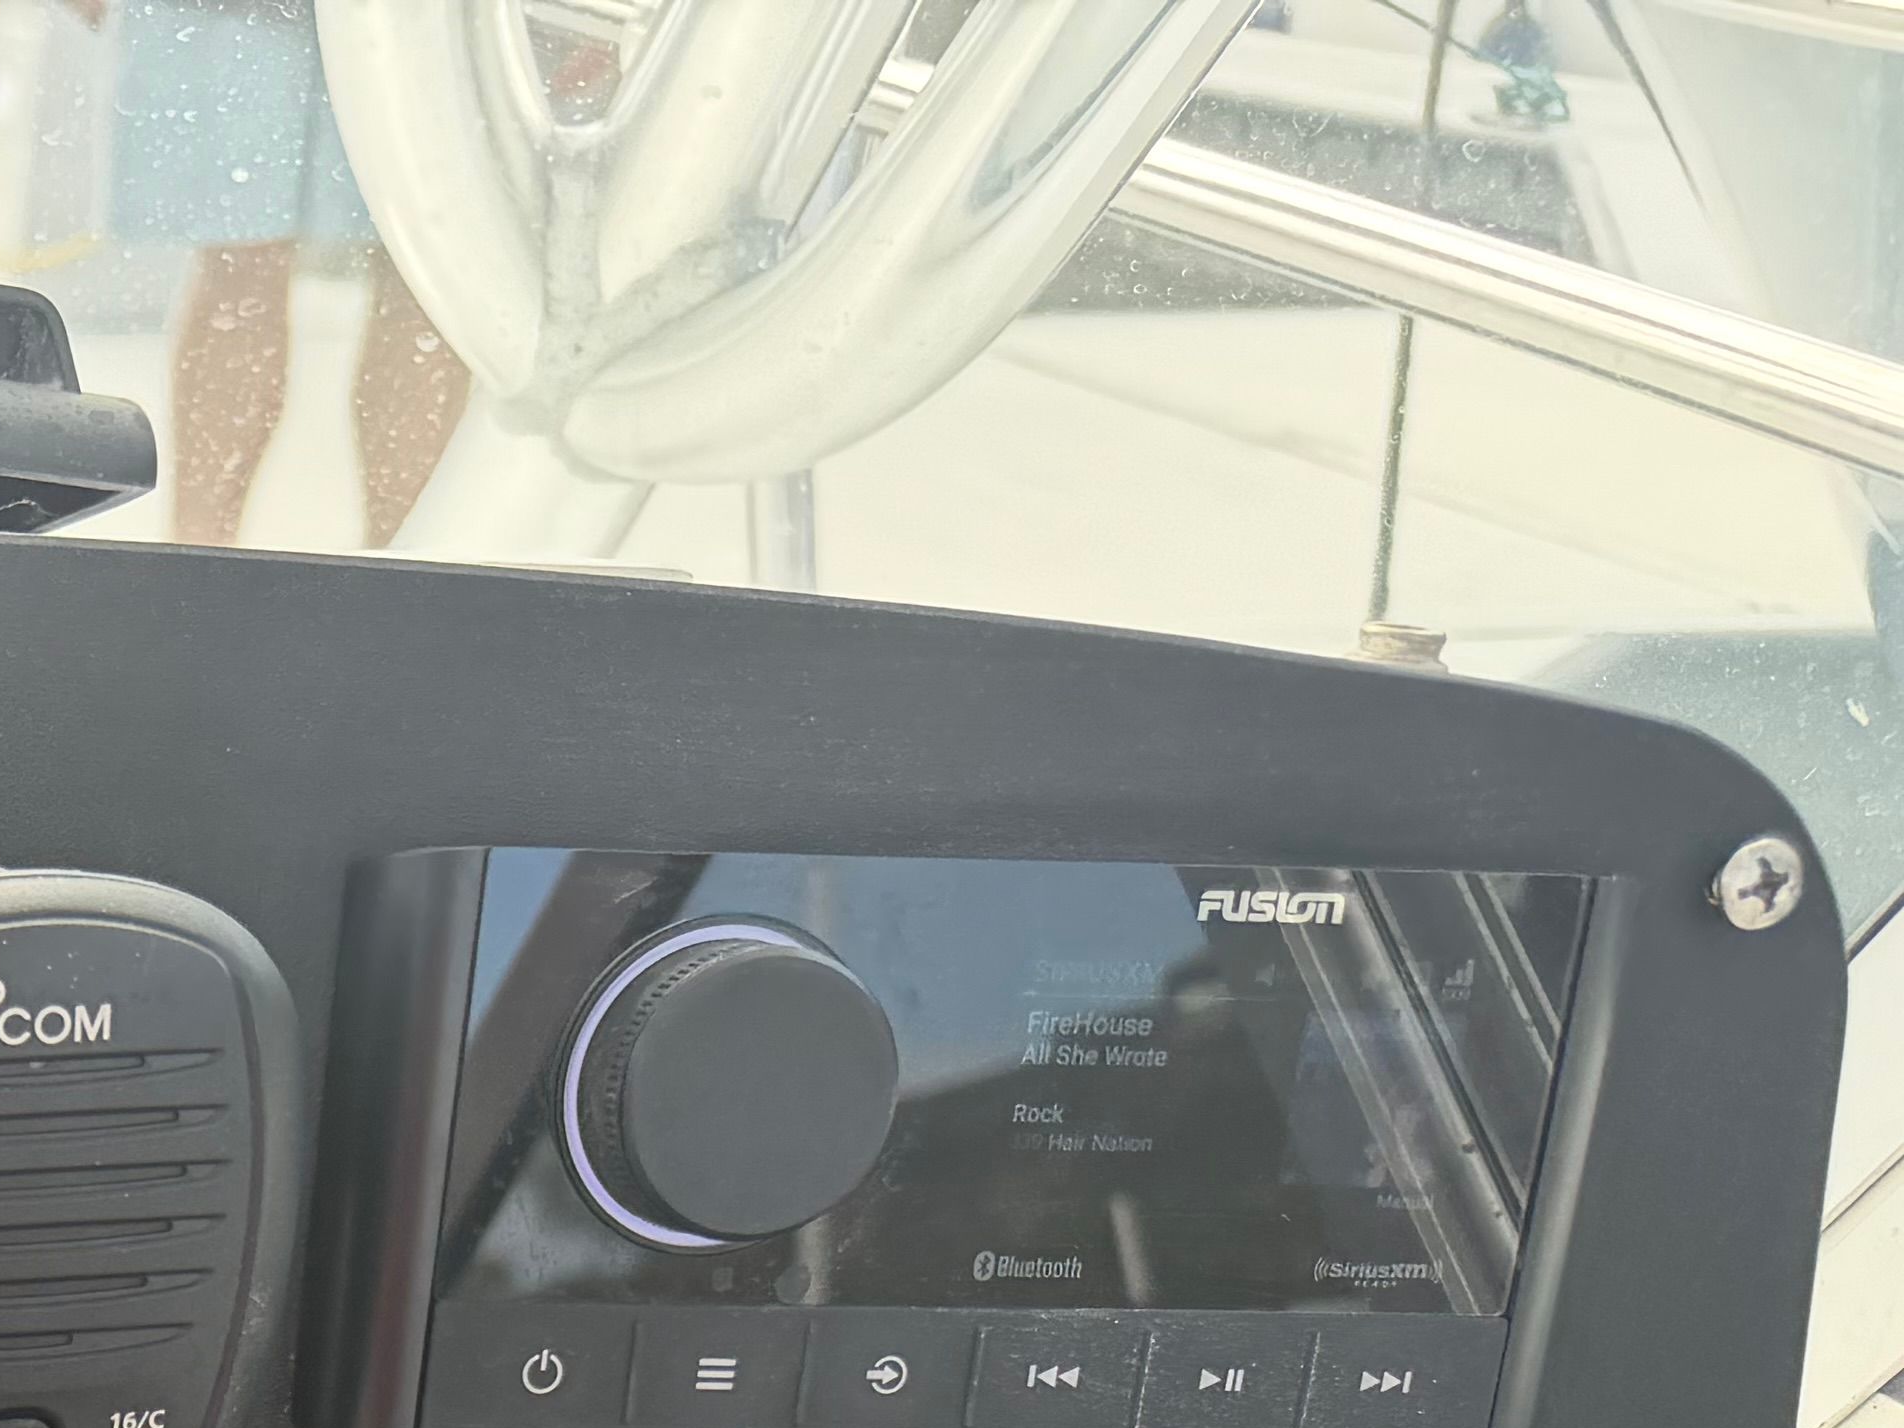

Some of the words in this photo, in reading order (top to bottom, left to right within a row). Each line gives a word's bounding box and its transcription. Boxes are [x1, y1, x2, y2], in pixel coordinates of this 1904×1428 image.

[1197, 890, 1345, 924] FUSION
[1027, 1011, 1153, 1035] FireHouse
[1013, 1104, 1063, 1123] Rock
[996, 1257, 1082, 1280] Bluetooth
